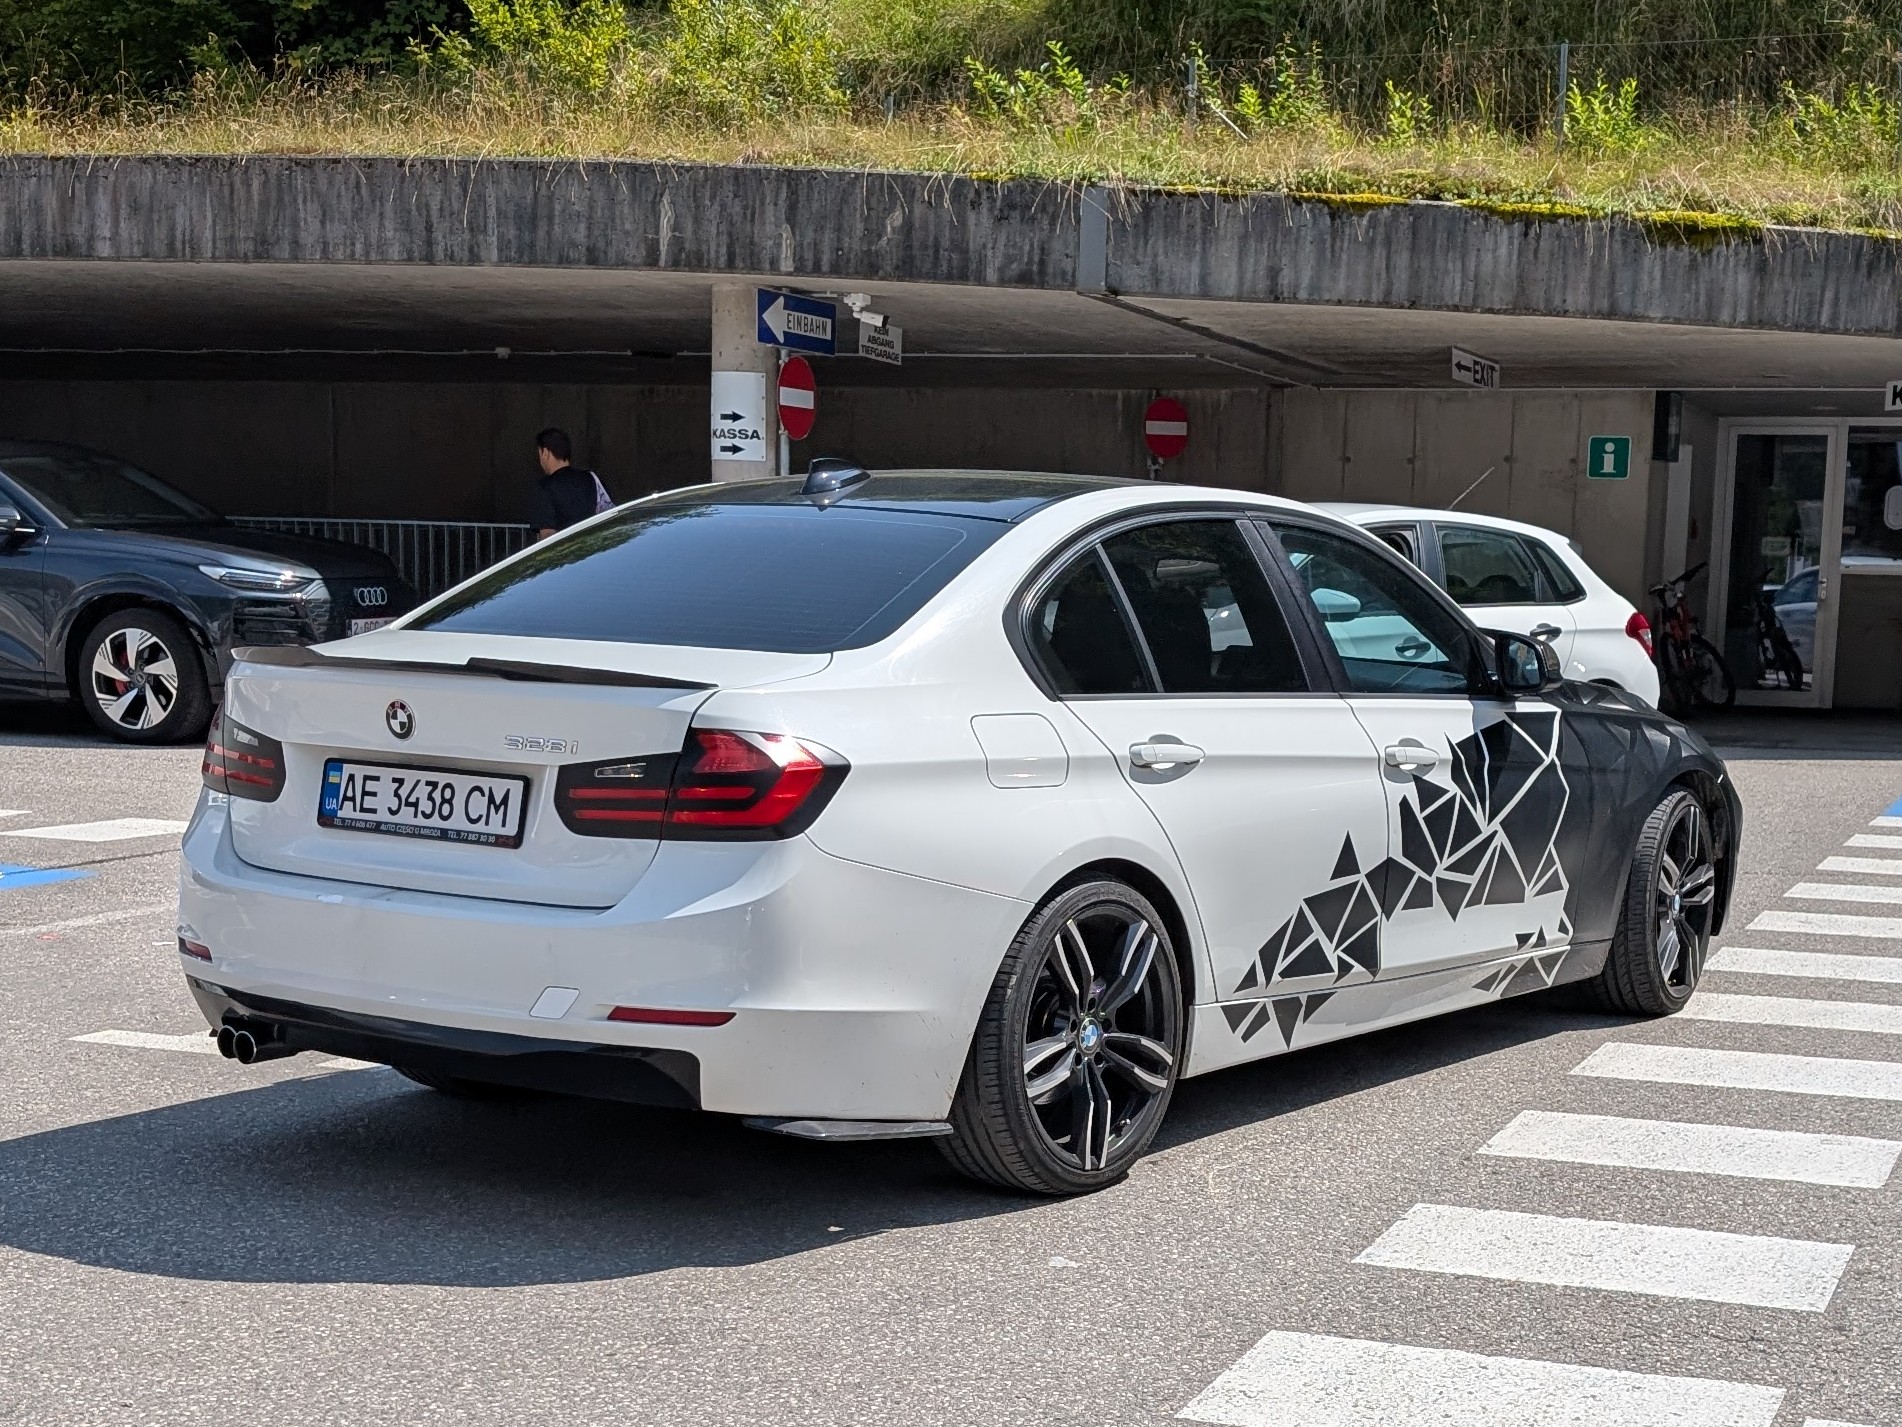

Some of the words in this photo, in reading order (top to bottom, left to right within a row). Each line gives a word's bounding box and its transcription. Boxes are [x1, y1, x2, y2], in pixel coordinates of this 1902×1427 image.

[786, 312, 828, 337] EINBAHN
[873, 325, 889, 337] KEIN
[867, 335, 894, 350] ABGANG
[861, 344, 900, 362] TIEFGARAGE
[1472, 359, 1496, 388] EXIT
[711, 428, 761, 441] KASSA
[503, 735, 579, 755] 328i
[325, 797, 337, 811] UA
[338, 773, 381, 814] AE
[387, 777, 456, 822] 3438
[464, 785, 511, 828] CM
[380, 823, 396, 832] AUTO
